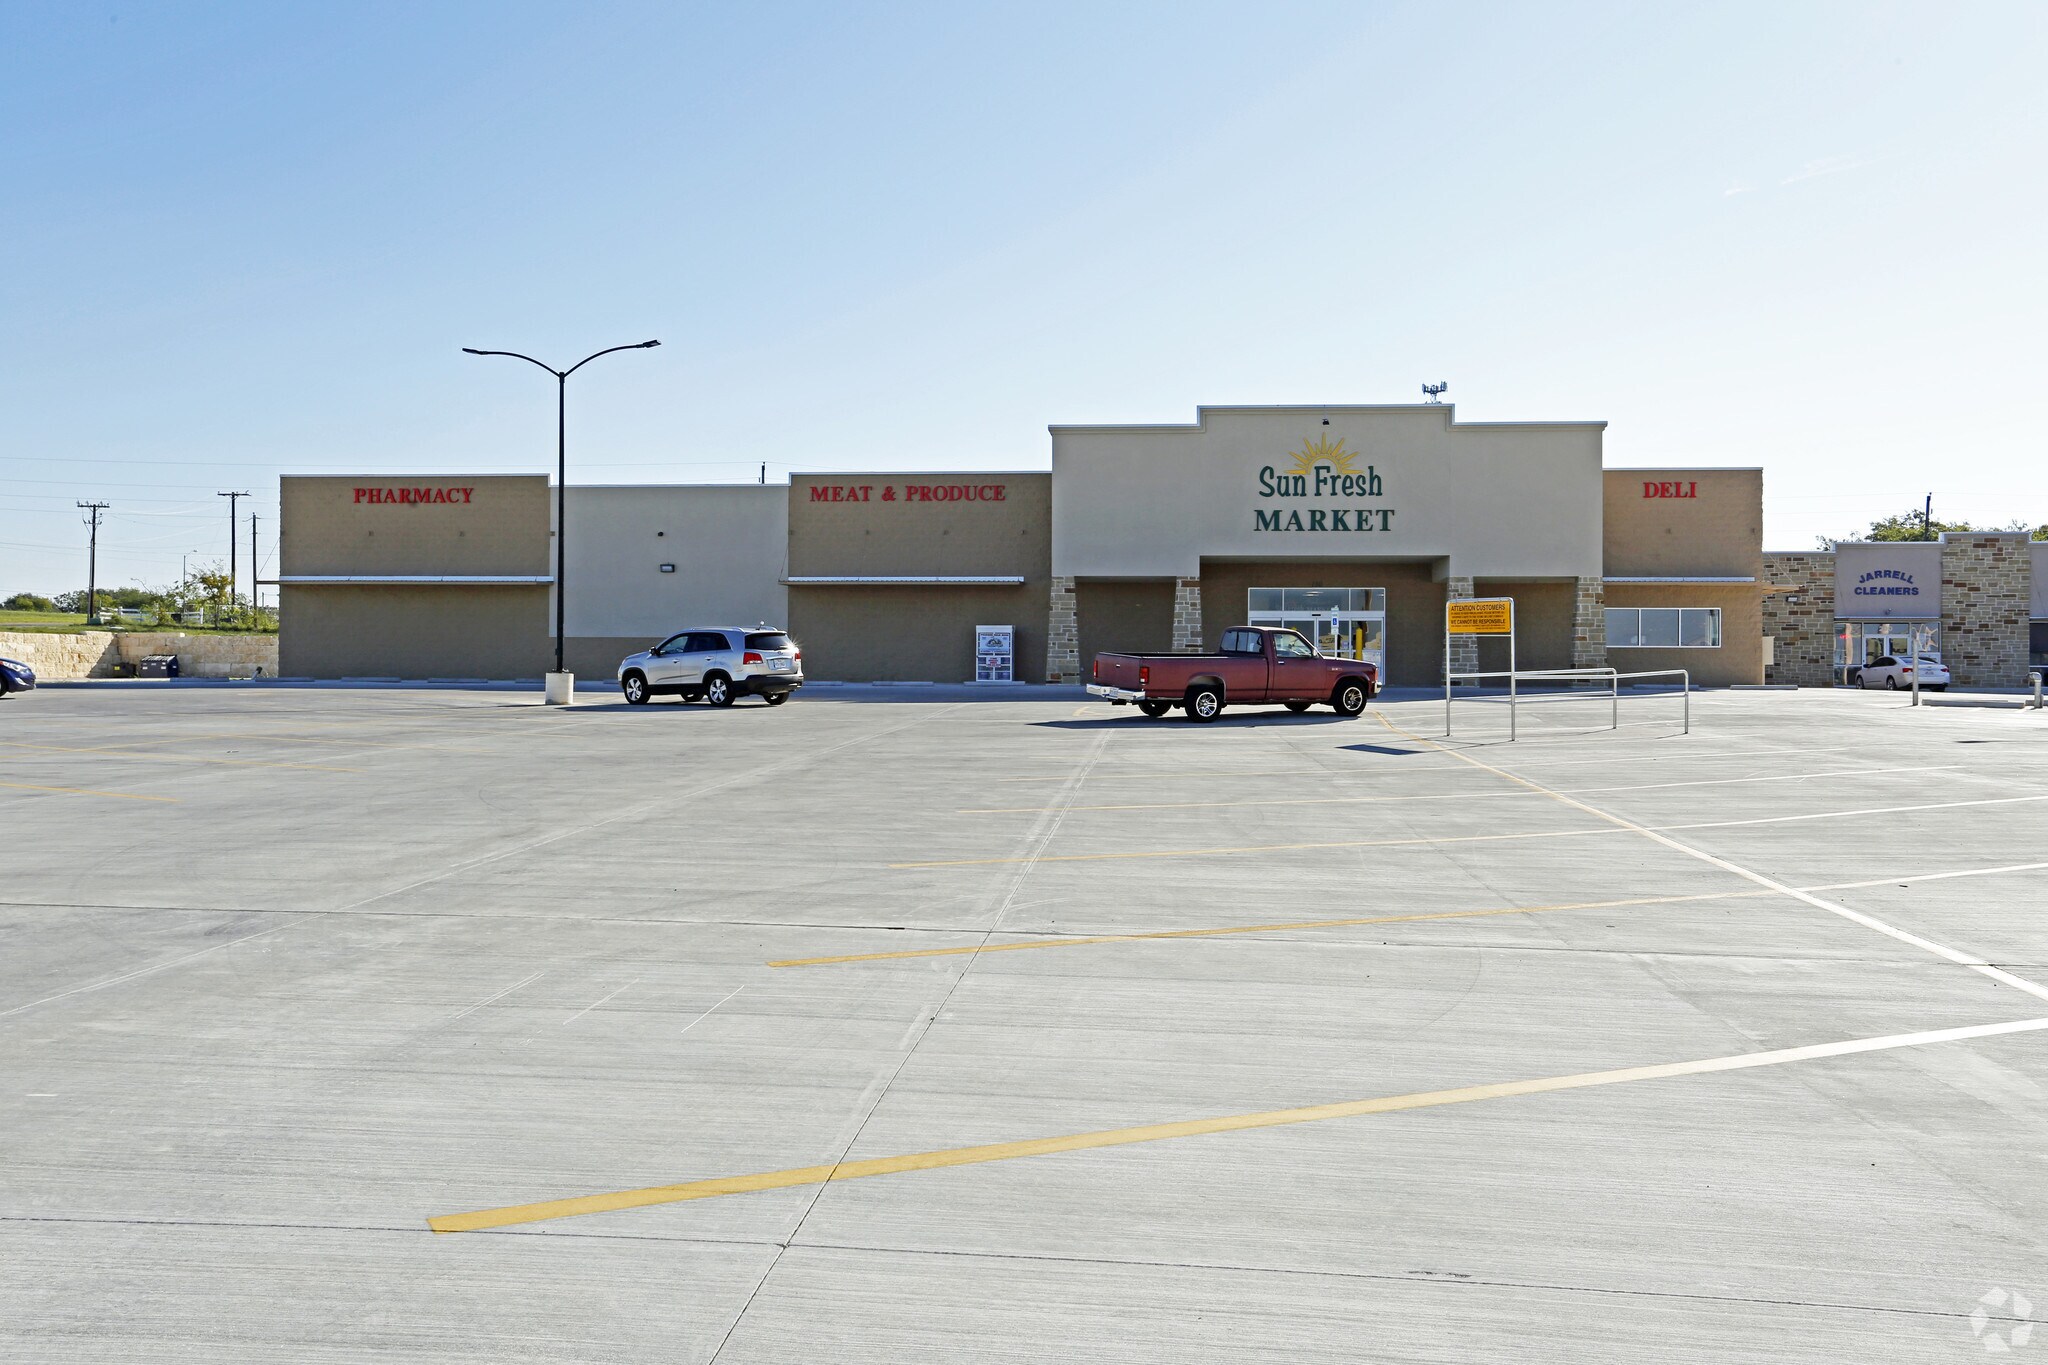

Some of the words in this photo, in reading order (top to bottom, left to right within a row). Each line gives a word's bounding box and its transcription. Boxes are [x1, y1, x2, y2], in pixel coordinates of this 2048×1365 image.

[1259, 465, 1307, 497] Sun
[1314, 465, 1383, 497] Fresh
[353, 488, 474, 503] PHARMACY
[809, 486, 873, 502] MEAT
[881, 486, 897, 502] &
[905, 485, 1006, 502] PRODUCE
[1643, 482, 1697, 498] DELI
[1253, 509, 1395, 531] MARKET
[1859, 570, 1914, 584] JARRELL
[1854, 586, 1919, 596] CLEANERS
